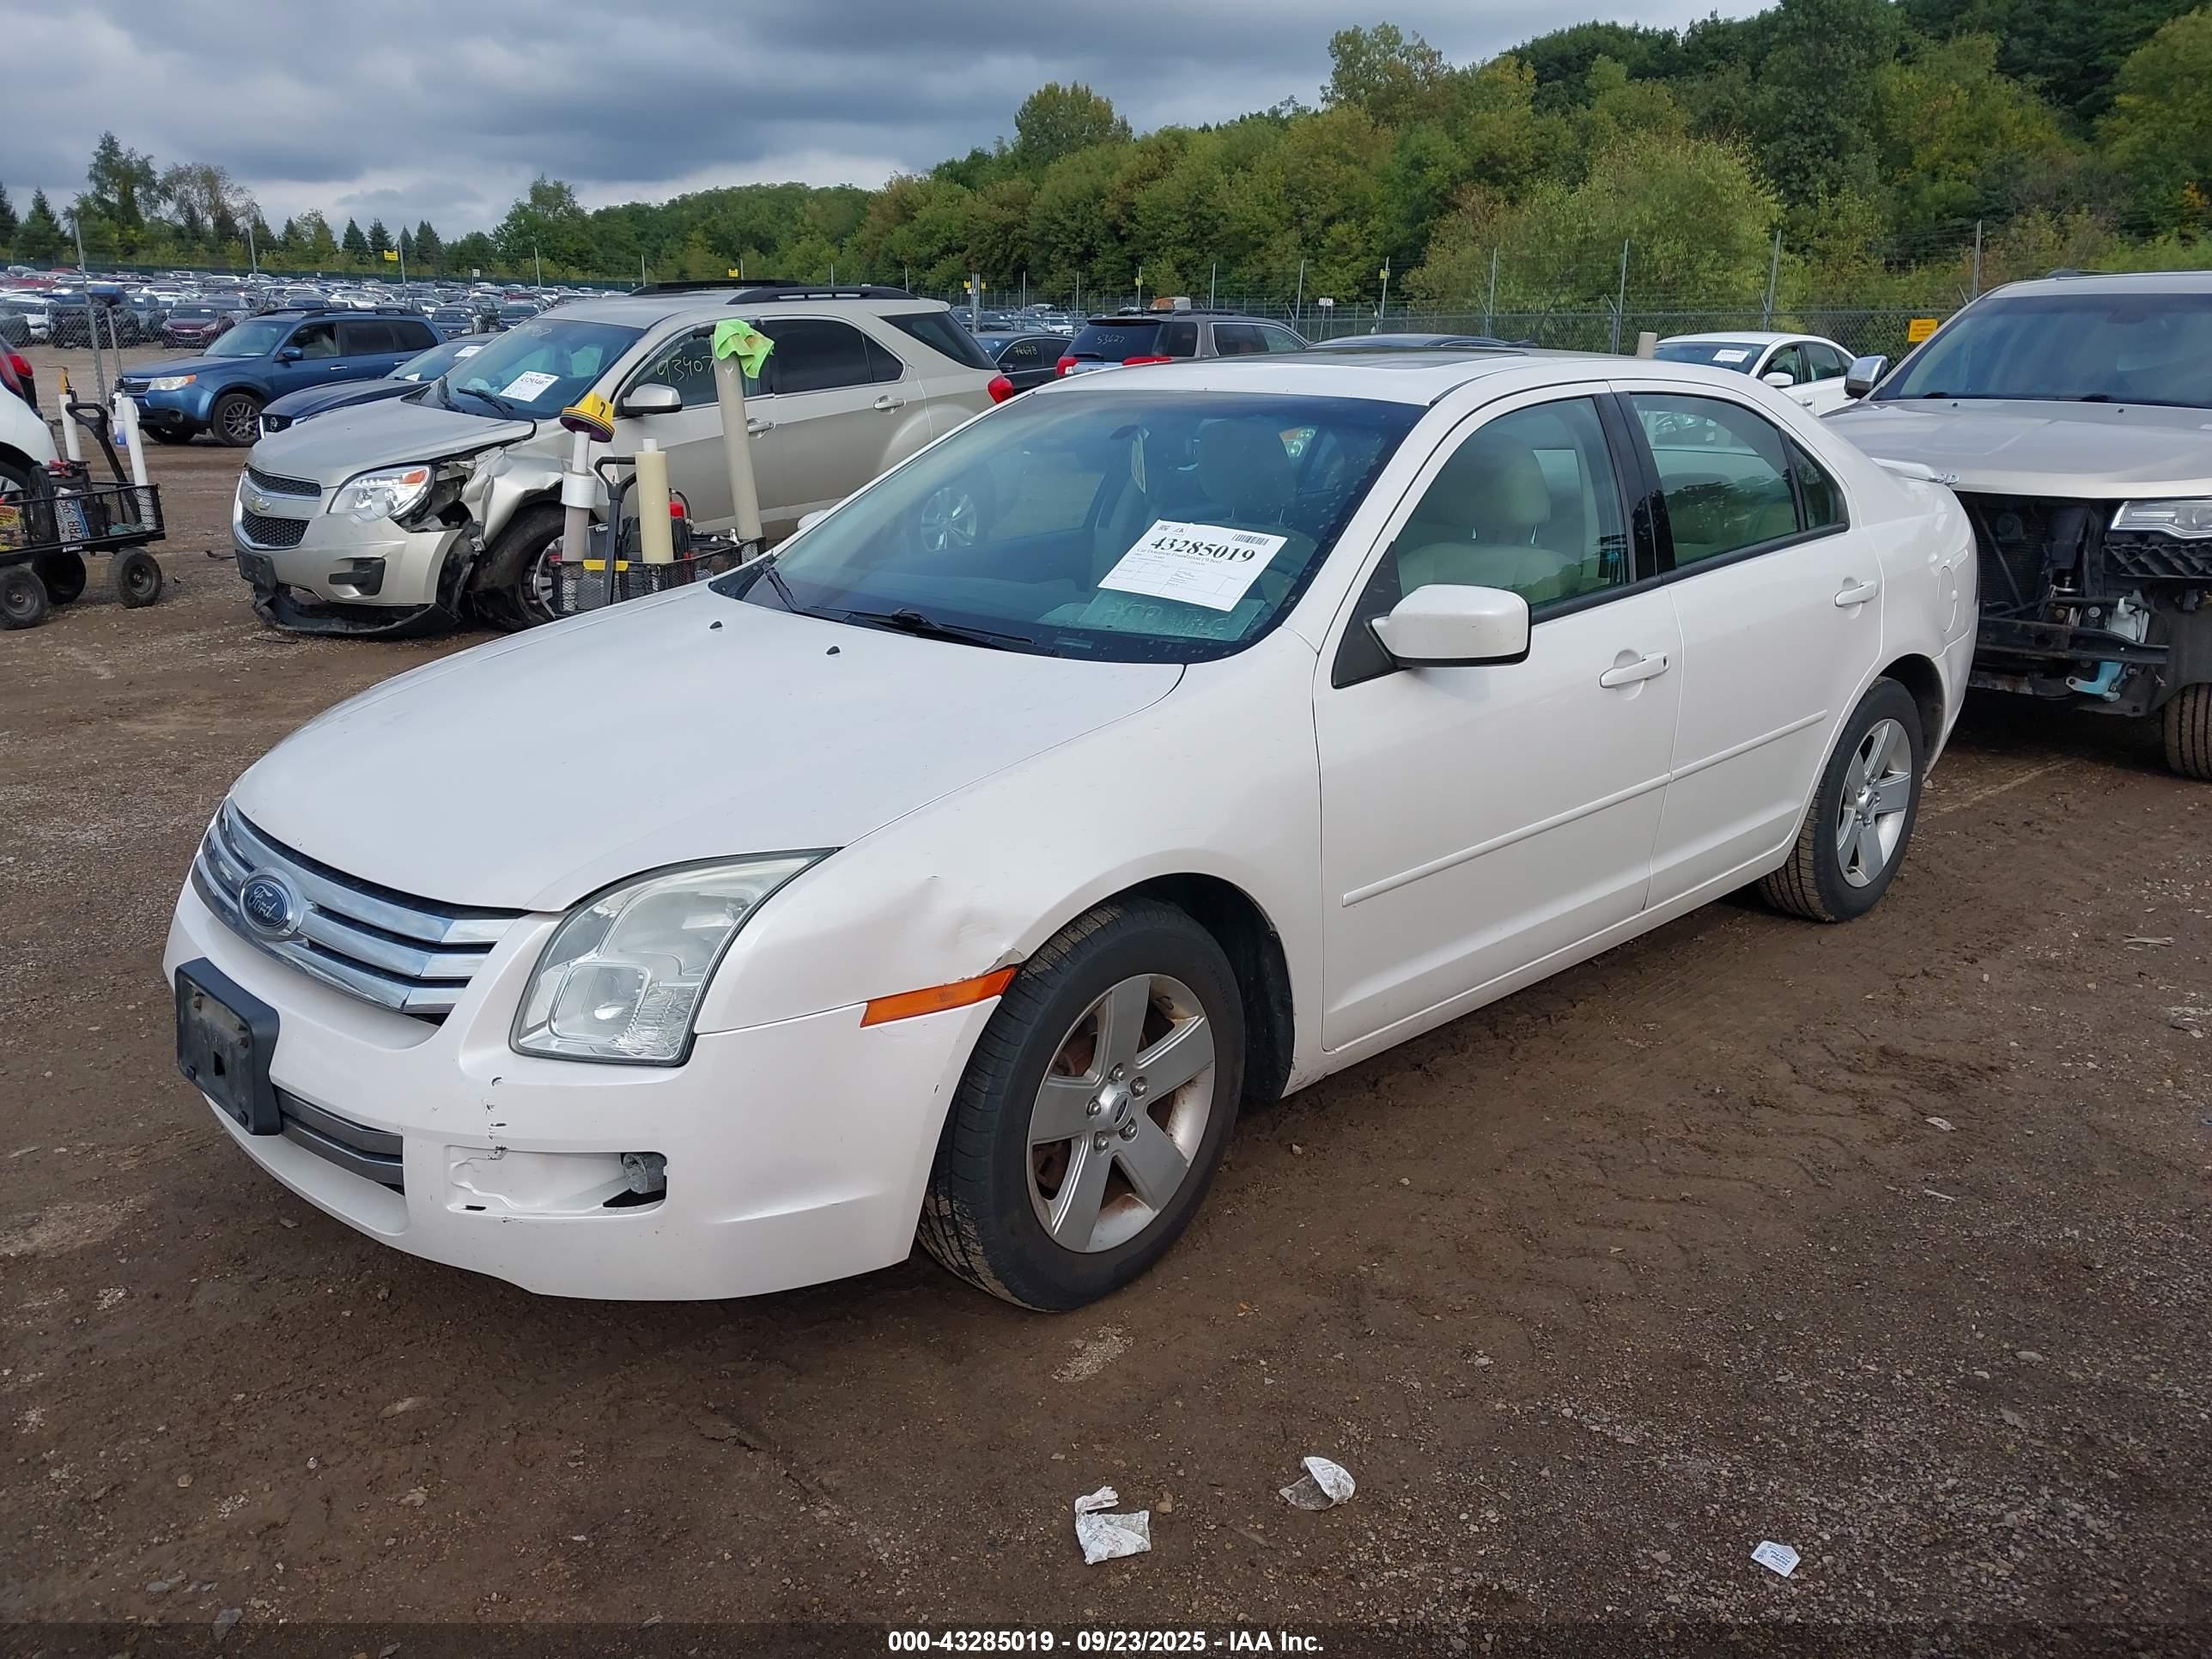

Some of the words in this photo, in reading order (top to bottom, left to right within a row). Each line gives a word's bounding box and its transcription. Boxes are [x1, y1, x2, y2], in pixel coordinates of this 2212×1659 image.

[599, 401, 606, 417] 2
[1150, 536, 1255, 563] 43285019
[247, 885, 278, 920] Ford
